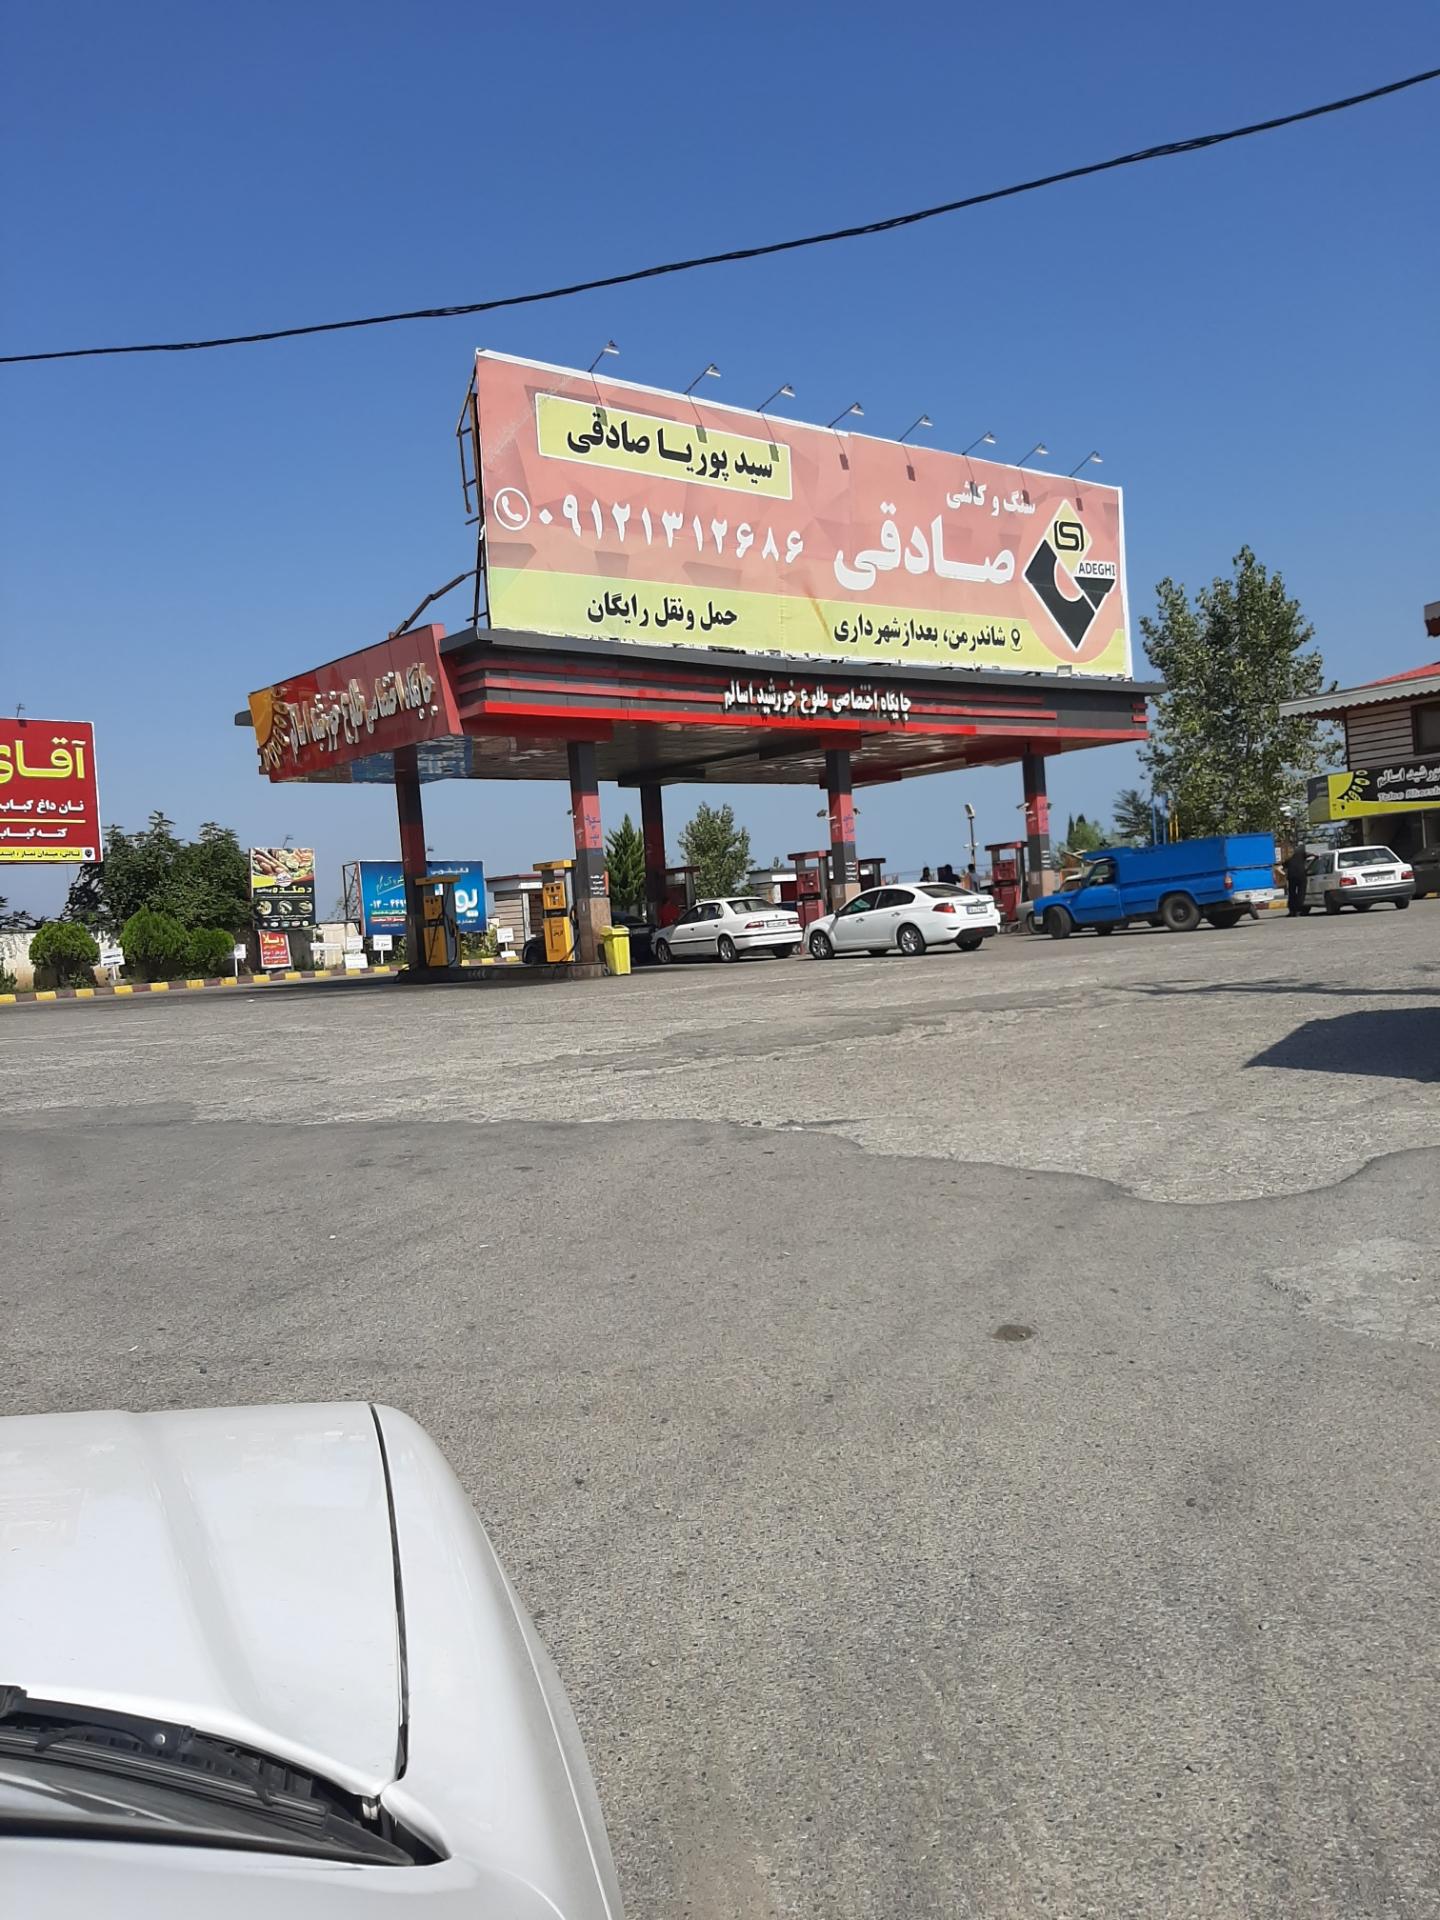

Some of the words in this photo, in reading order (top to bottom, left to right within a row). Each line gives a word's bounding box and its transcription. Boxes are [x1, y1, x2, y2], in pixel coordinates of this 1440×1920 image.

[567, 410, 651, 454] صادقی
[657, 428, 729, 482] پوریا
[734, 451, 773, 484] سید
[991, 495, 1000, 516] و
[1003, 488, 1036, 515] سنگ
[539, 494, 803, 564] ۰۹۱۲۱۳۱۲۶۸۶
[833, 502, 1015, 591] صادقی
[1078, 561, 1117, 577] ADEGHI
[587, 591, 650, 627] رایگان
[700, 601, 738, 631] حمل
[724, 678, 753, 710] اسالم
[757, 677, 797, 715] خورشید
[800, 685, 828, 714] طلوع
[832, 683, 878, 713] اختصاصی
[881, 689, 912, 720] جایگاه
[36, 798, 57, 814] داغ
[59, 799, 84, 814] نان
[37, 827, 68, 838] کته
